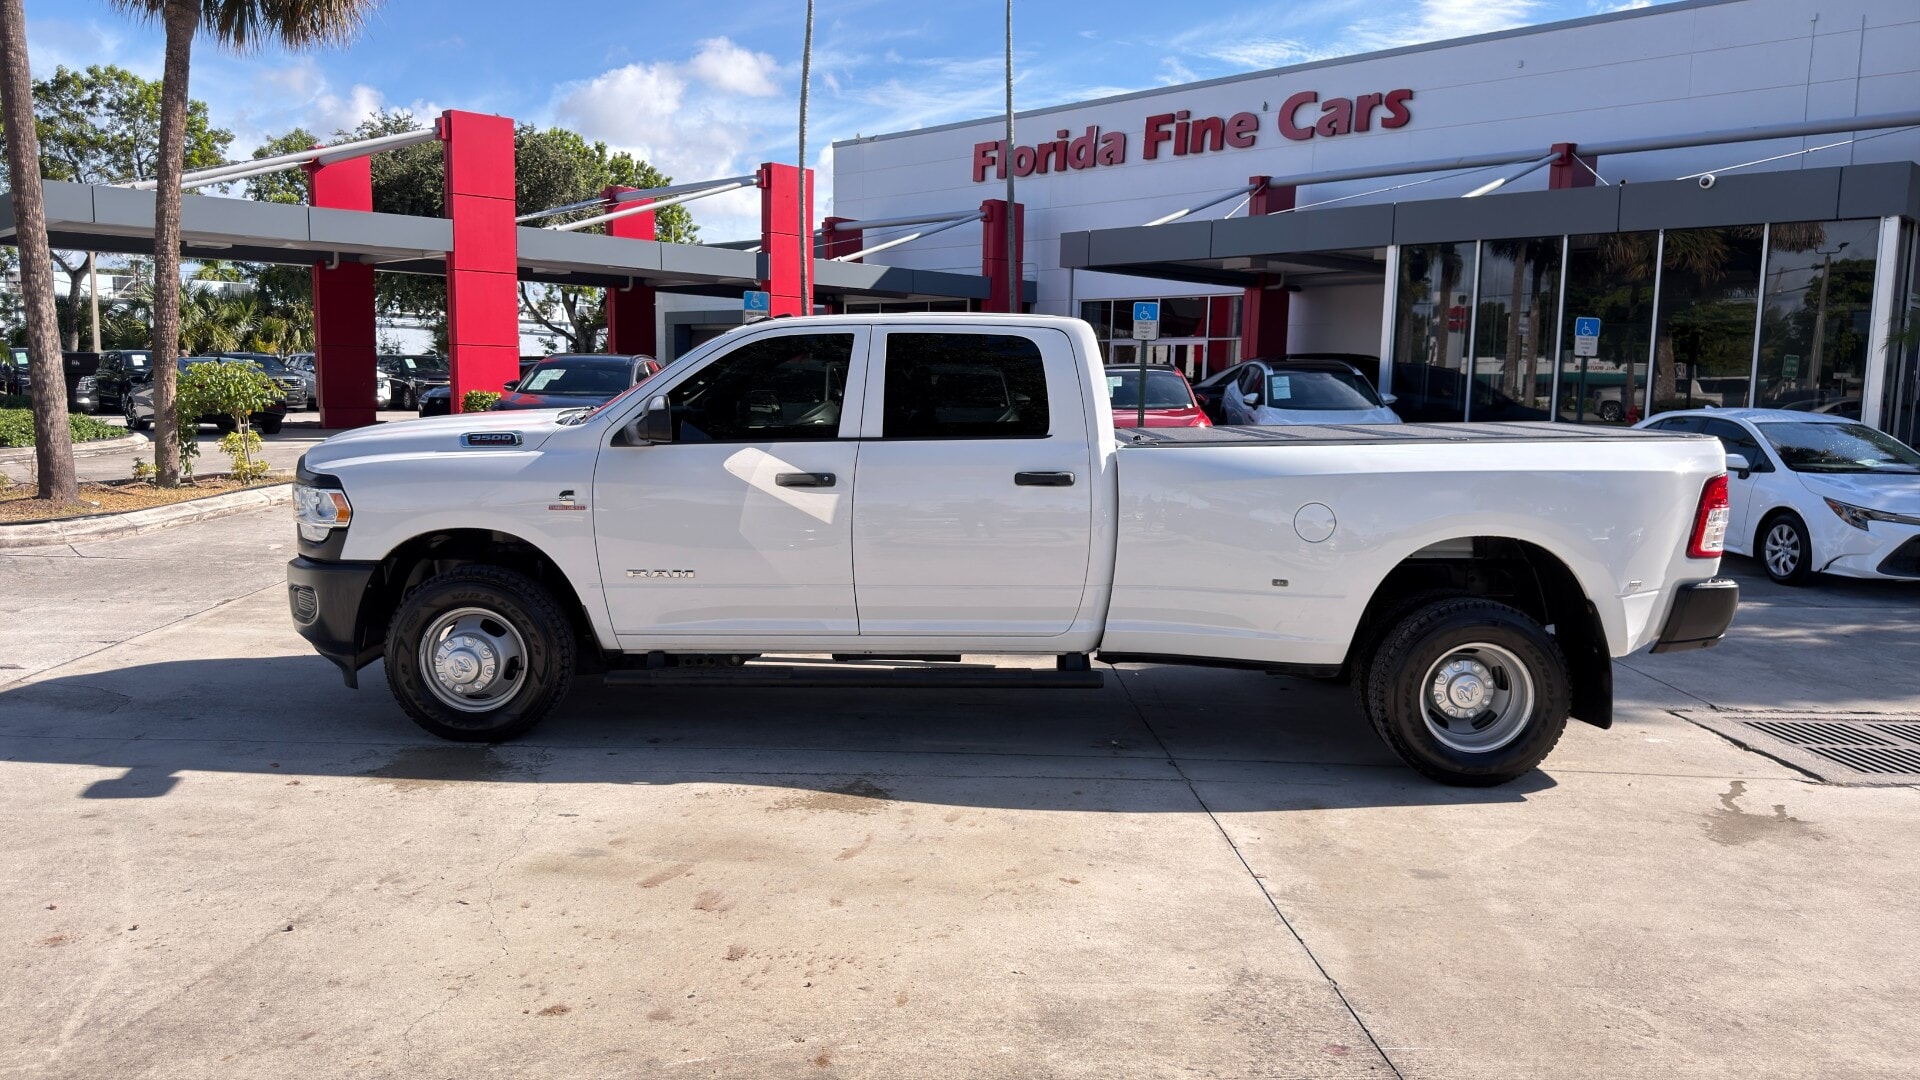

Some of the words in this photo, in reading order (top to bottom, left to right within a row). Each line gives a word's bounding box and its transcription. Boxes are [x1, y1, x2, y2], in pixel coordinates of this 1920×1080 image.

[972, 125, 1126, 183] Florida
[1142, 109, 1260, 161] Fine
[1276, 88, 1414, 142] Cars
[626, 569, 695, 578] RAM
[450, 591, 542, 657] WRANGLER
